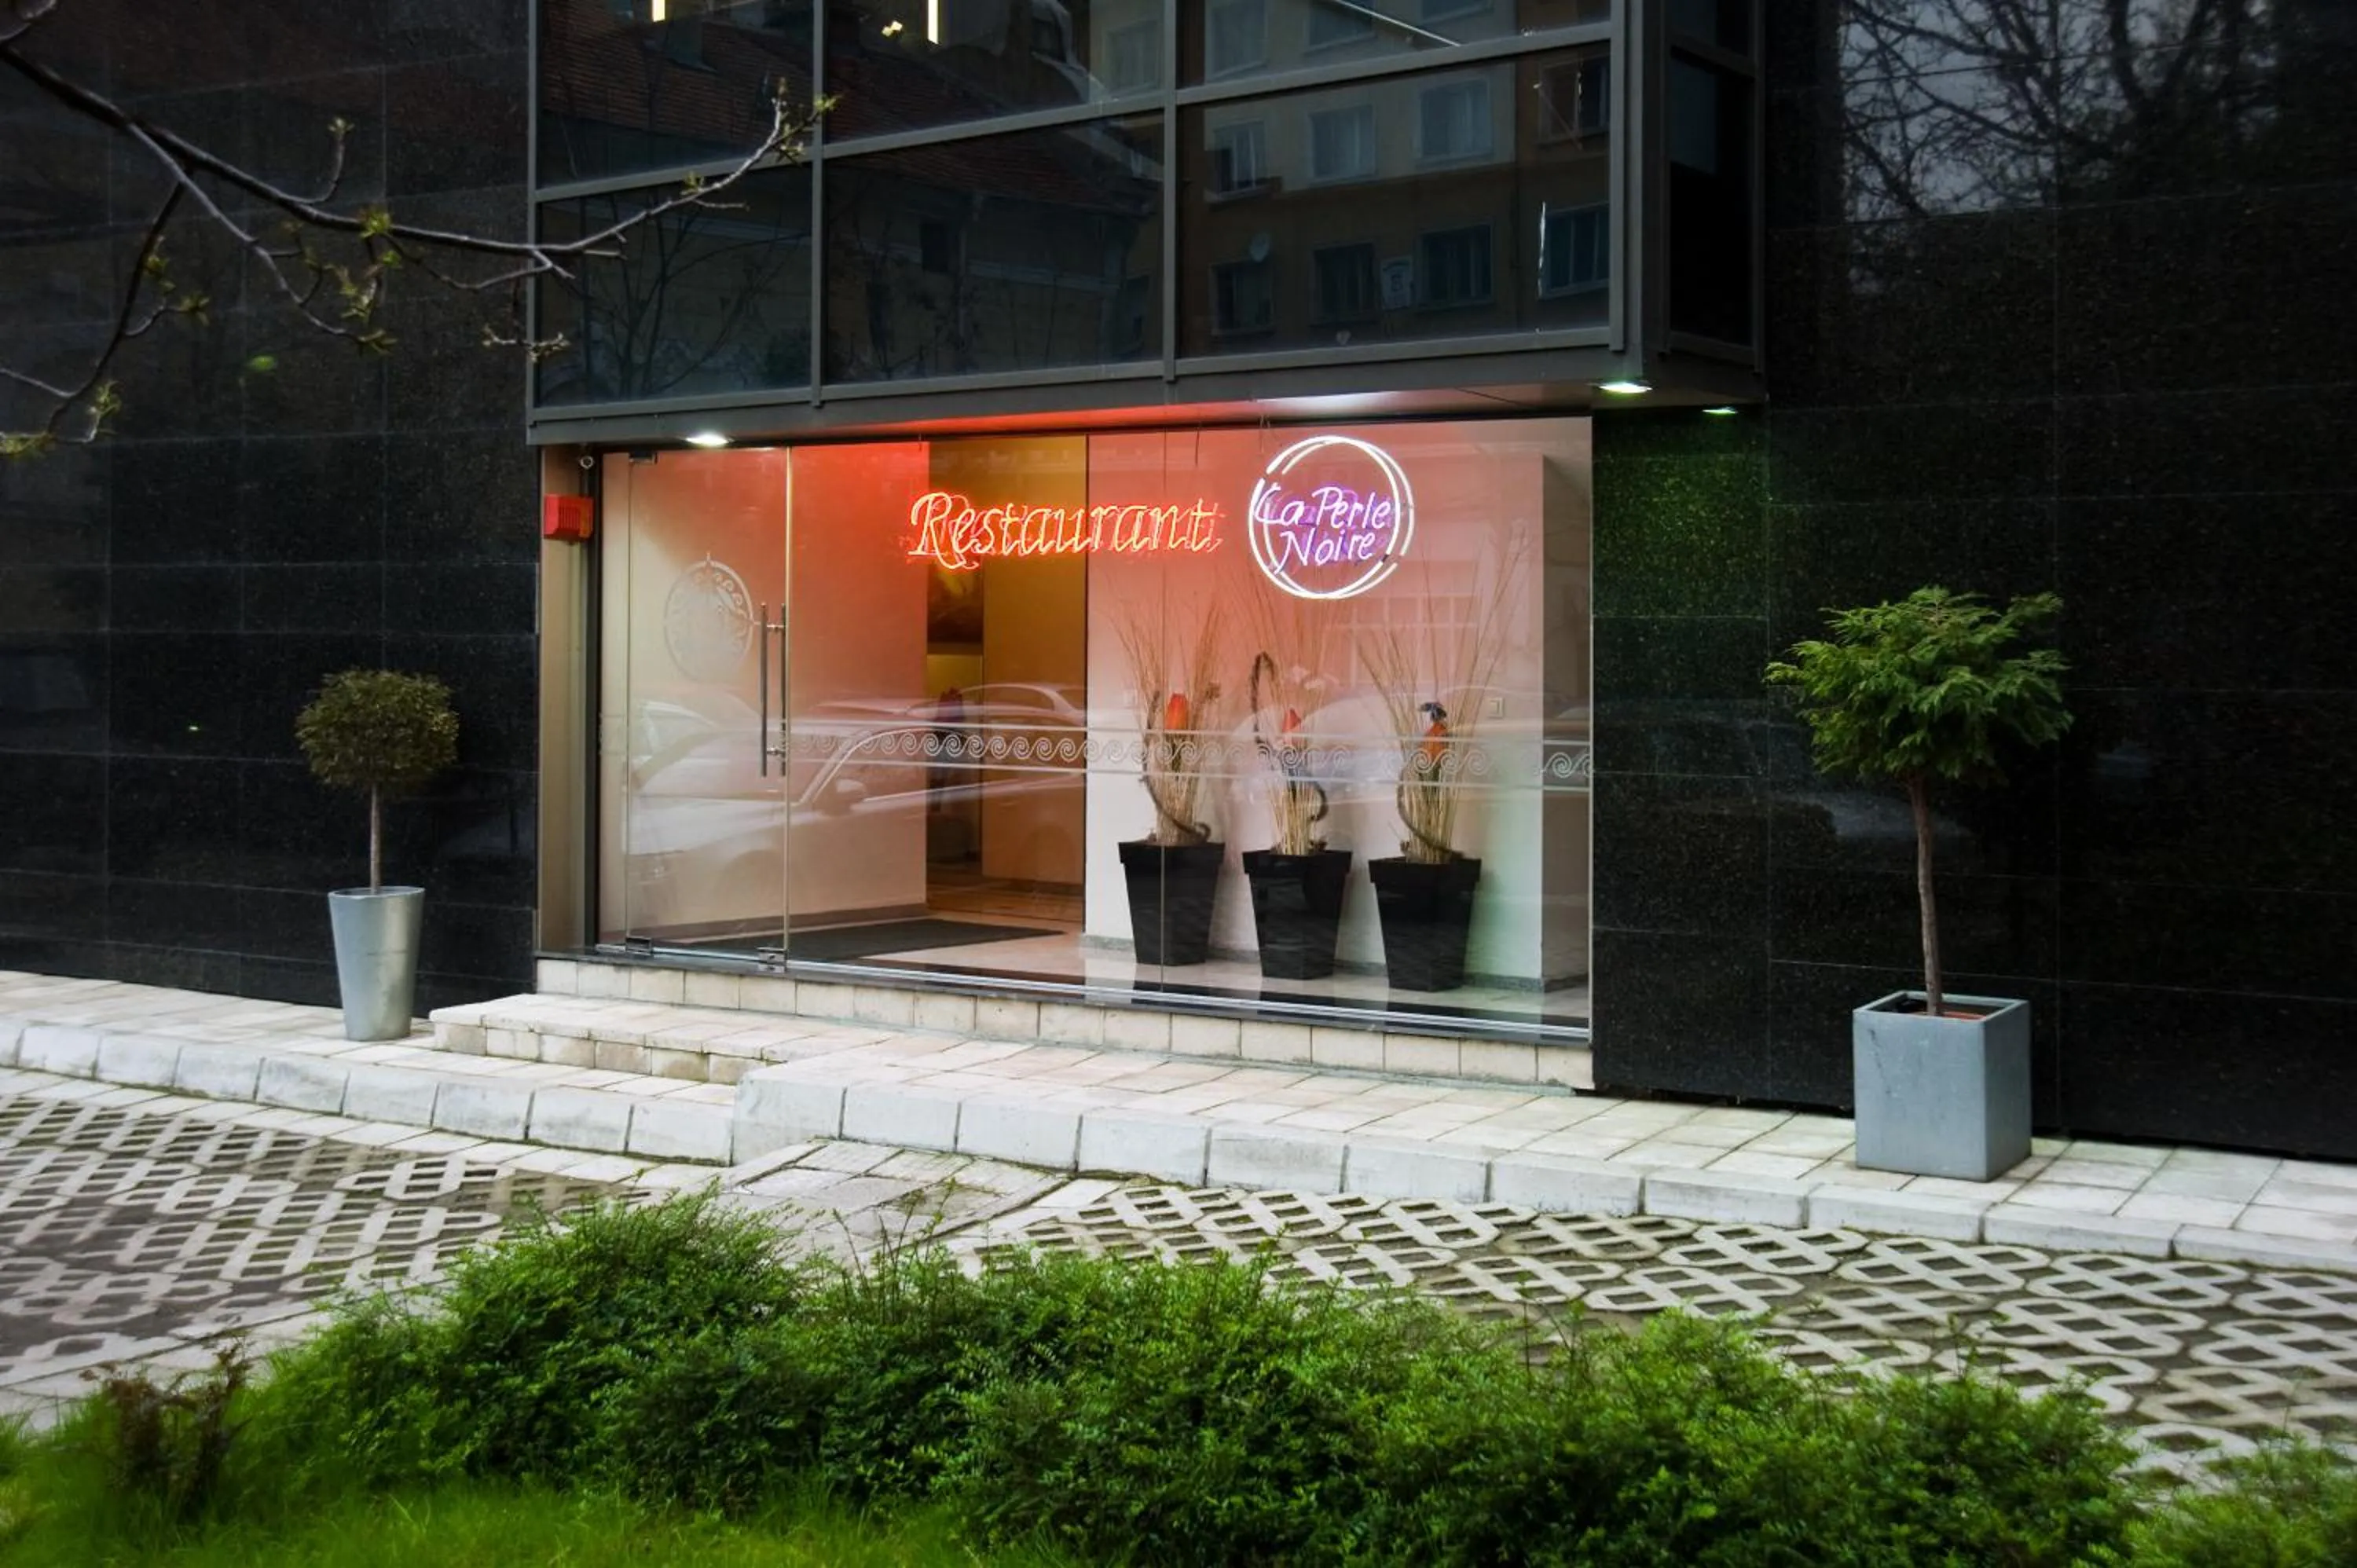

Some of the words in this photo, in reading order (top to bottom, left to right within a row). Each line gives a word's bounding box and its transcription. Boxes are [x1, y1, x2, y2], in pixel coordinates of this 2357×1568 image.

[1254, 482, 1306, 526] La
[1311, 486, 1391, 529] Perle
[908, 491, 1219, 570] Restaurant
[1273, 527, 1376, 575] Noire
